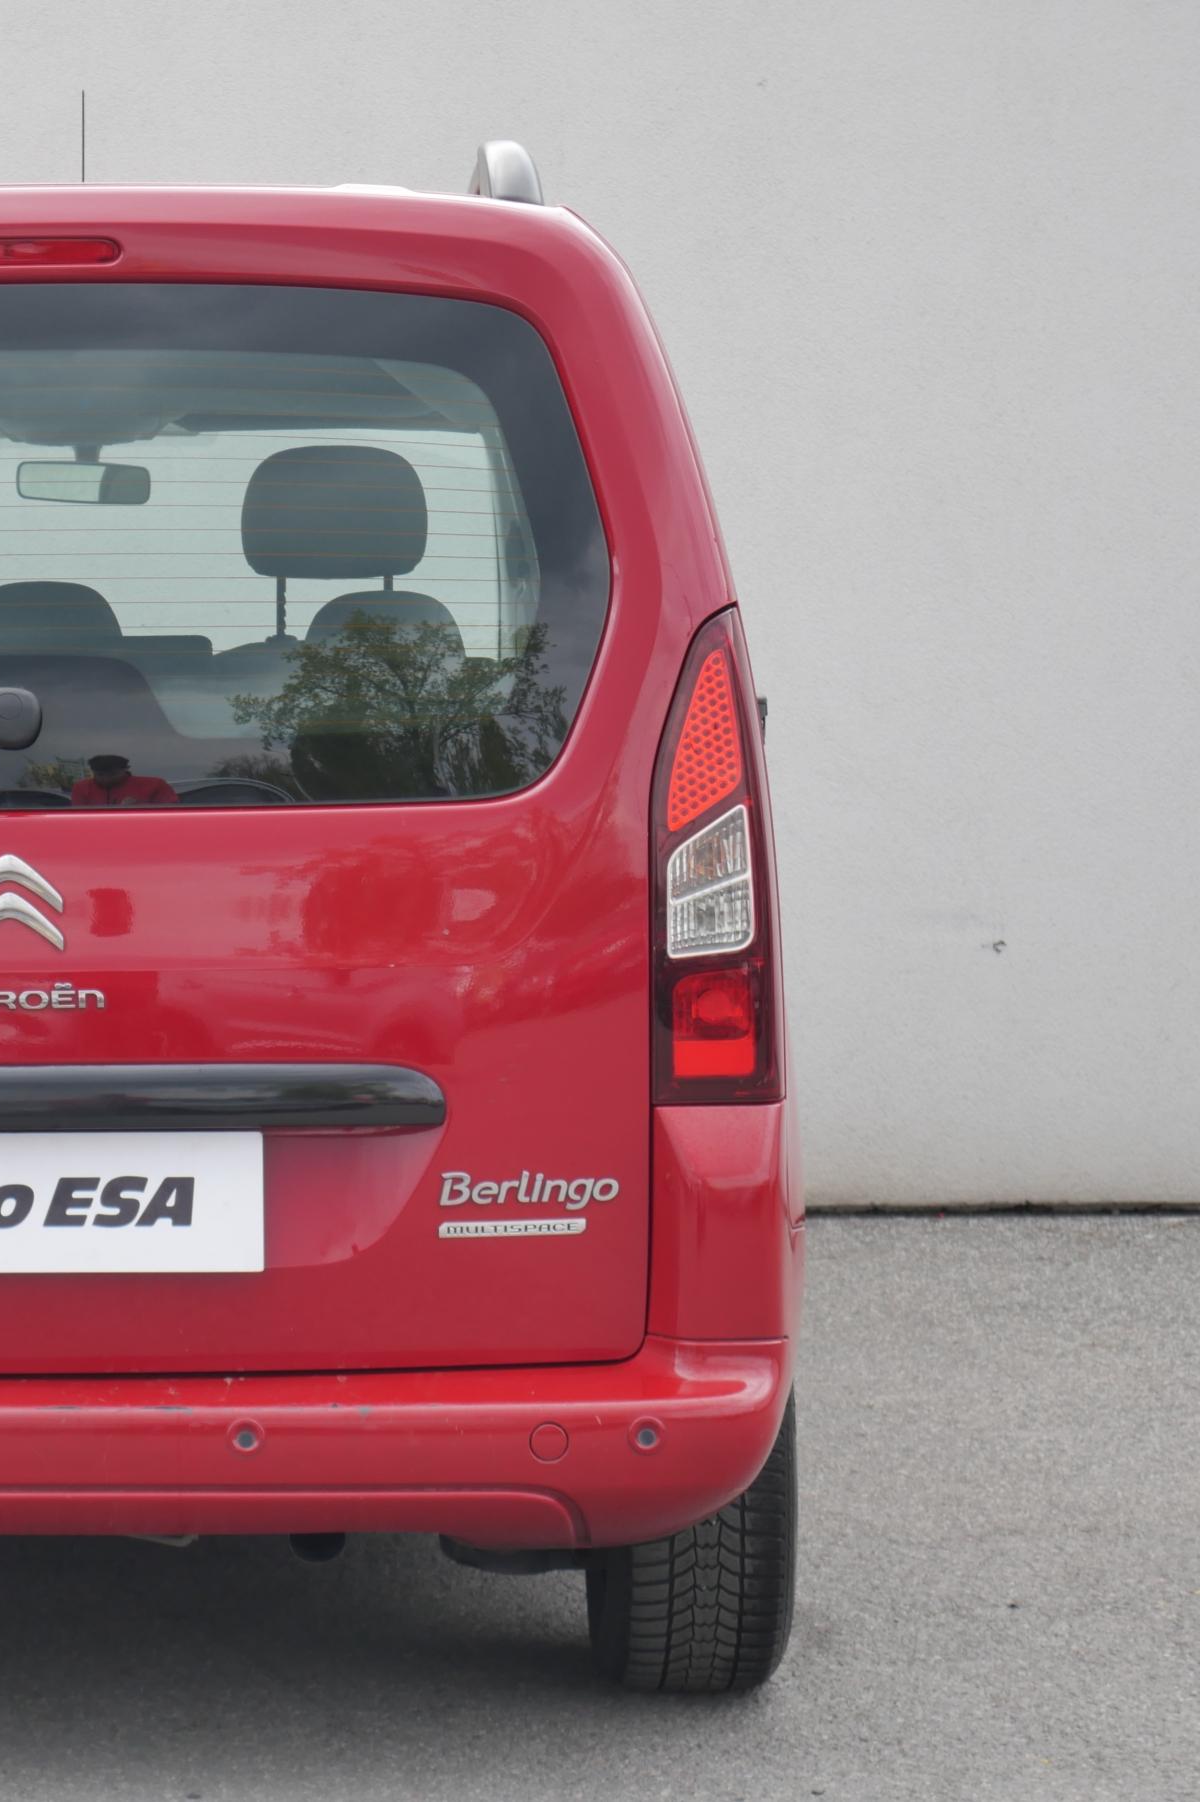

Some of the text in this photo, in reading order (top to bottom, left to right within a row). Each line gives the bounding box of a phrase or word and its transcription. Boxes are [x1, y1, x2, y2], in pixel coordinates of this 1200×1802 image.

[43, 1175, 196, 1228] ESA
[439, 1170, 620, 1211] Berlingo
[445, 1221, 580, 1235] MULTISPACE
